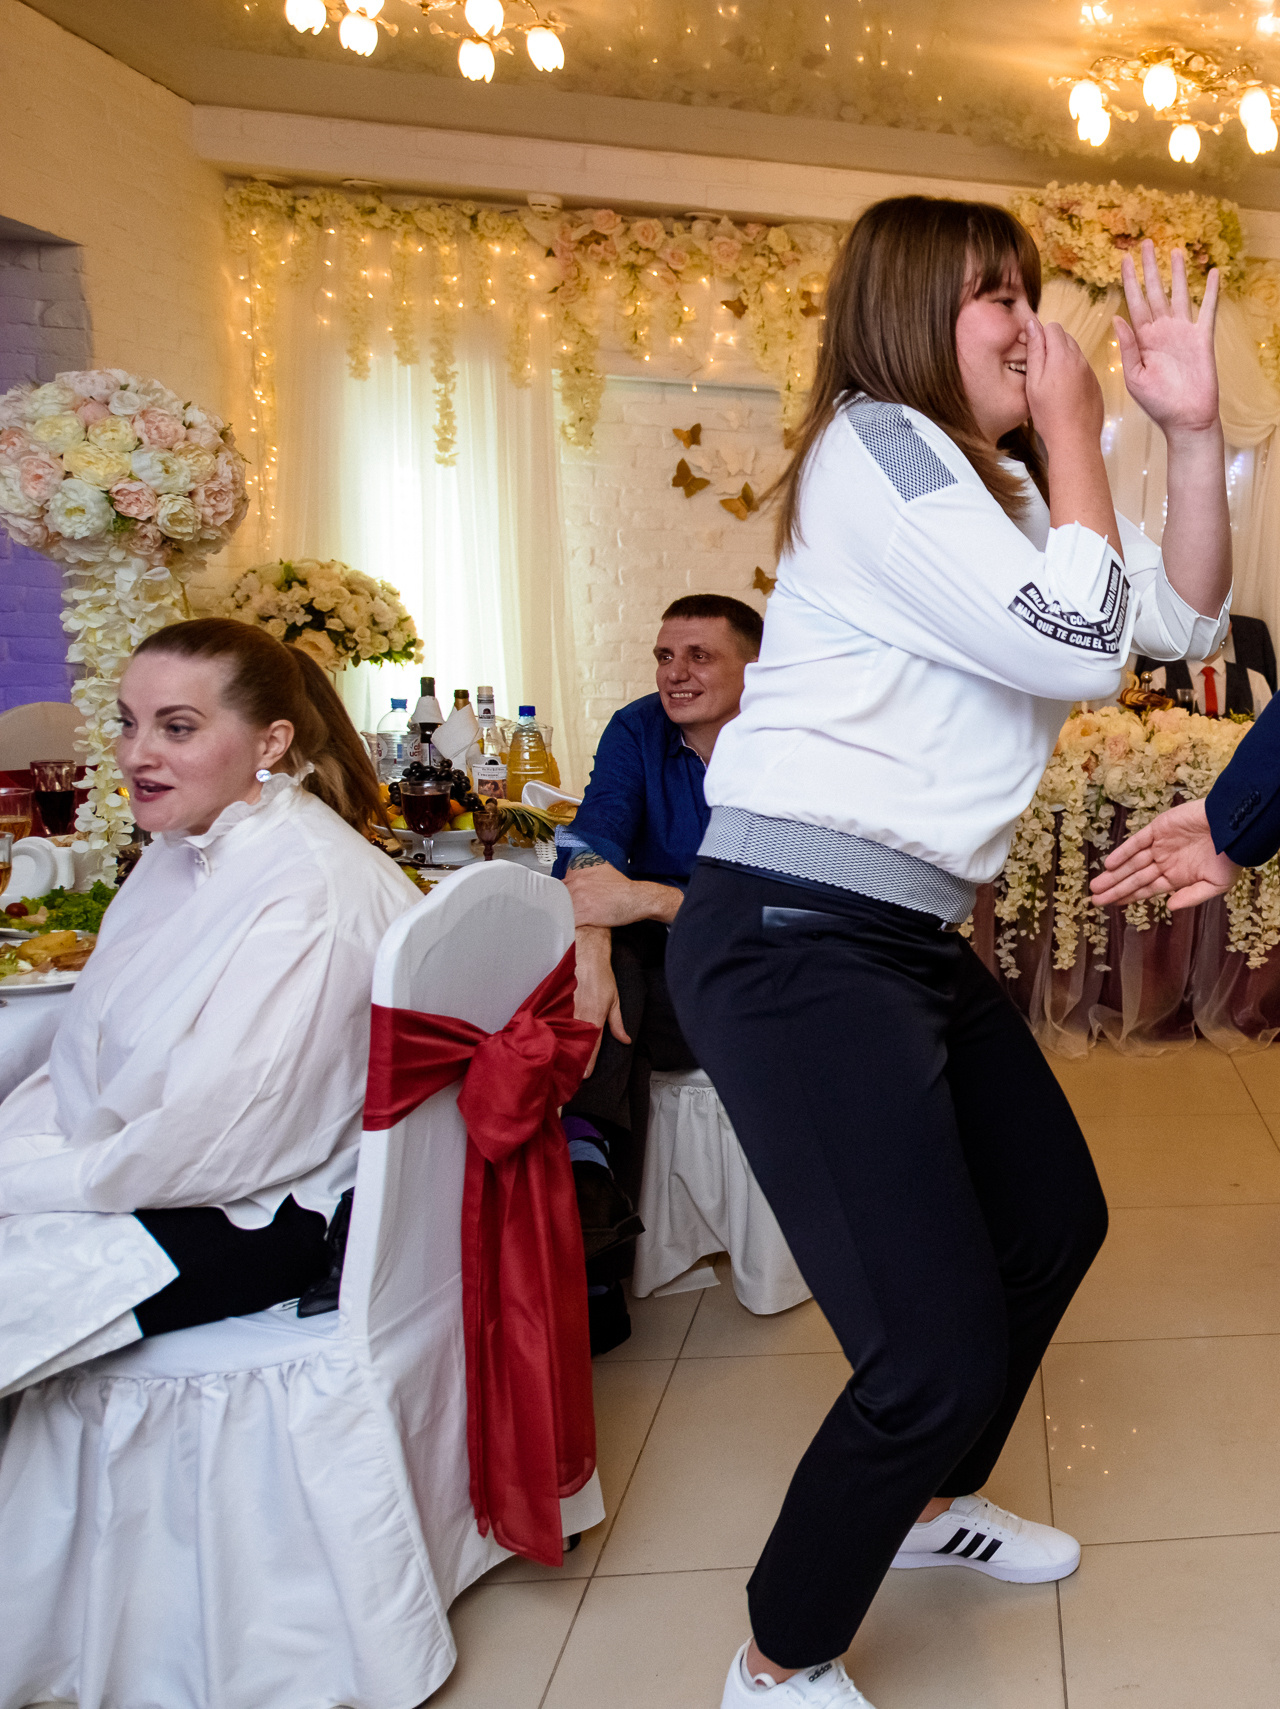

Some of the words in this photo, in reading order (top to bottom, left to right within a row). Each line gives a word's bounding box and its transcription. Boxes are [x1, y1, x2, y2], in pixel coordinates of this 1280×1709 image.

[1026, 587, 1046, 610] HALA
[1015, 602, 1036, 624] HALA
[1036, 620, 1054, 635] QUE
[1055, 627, 1068, 641] TE
[1069, 634, 1091, 647] COJE
[1092, 639, 1103, 650] EL
[1105, 641, 1118, 652] TO
